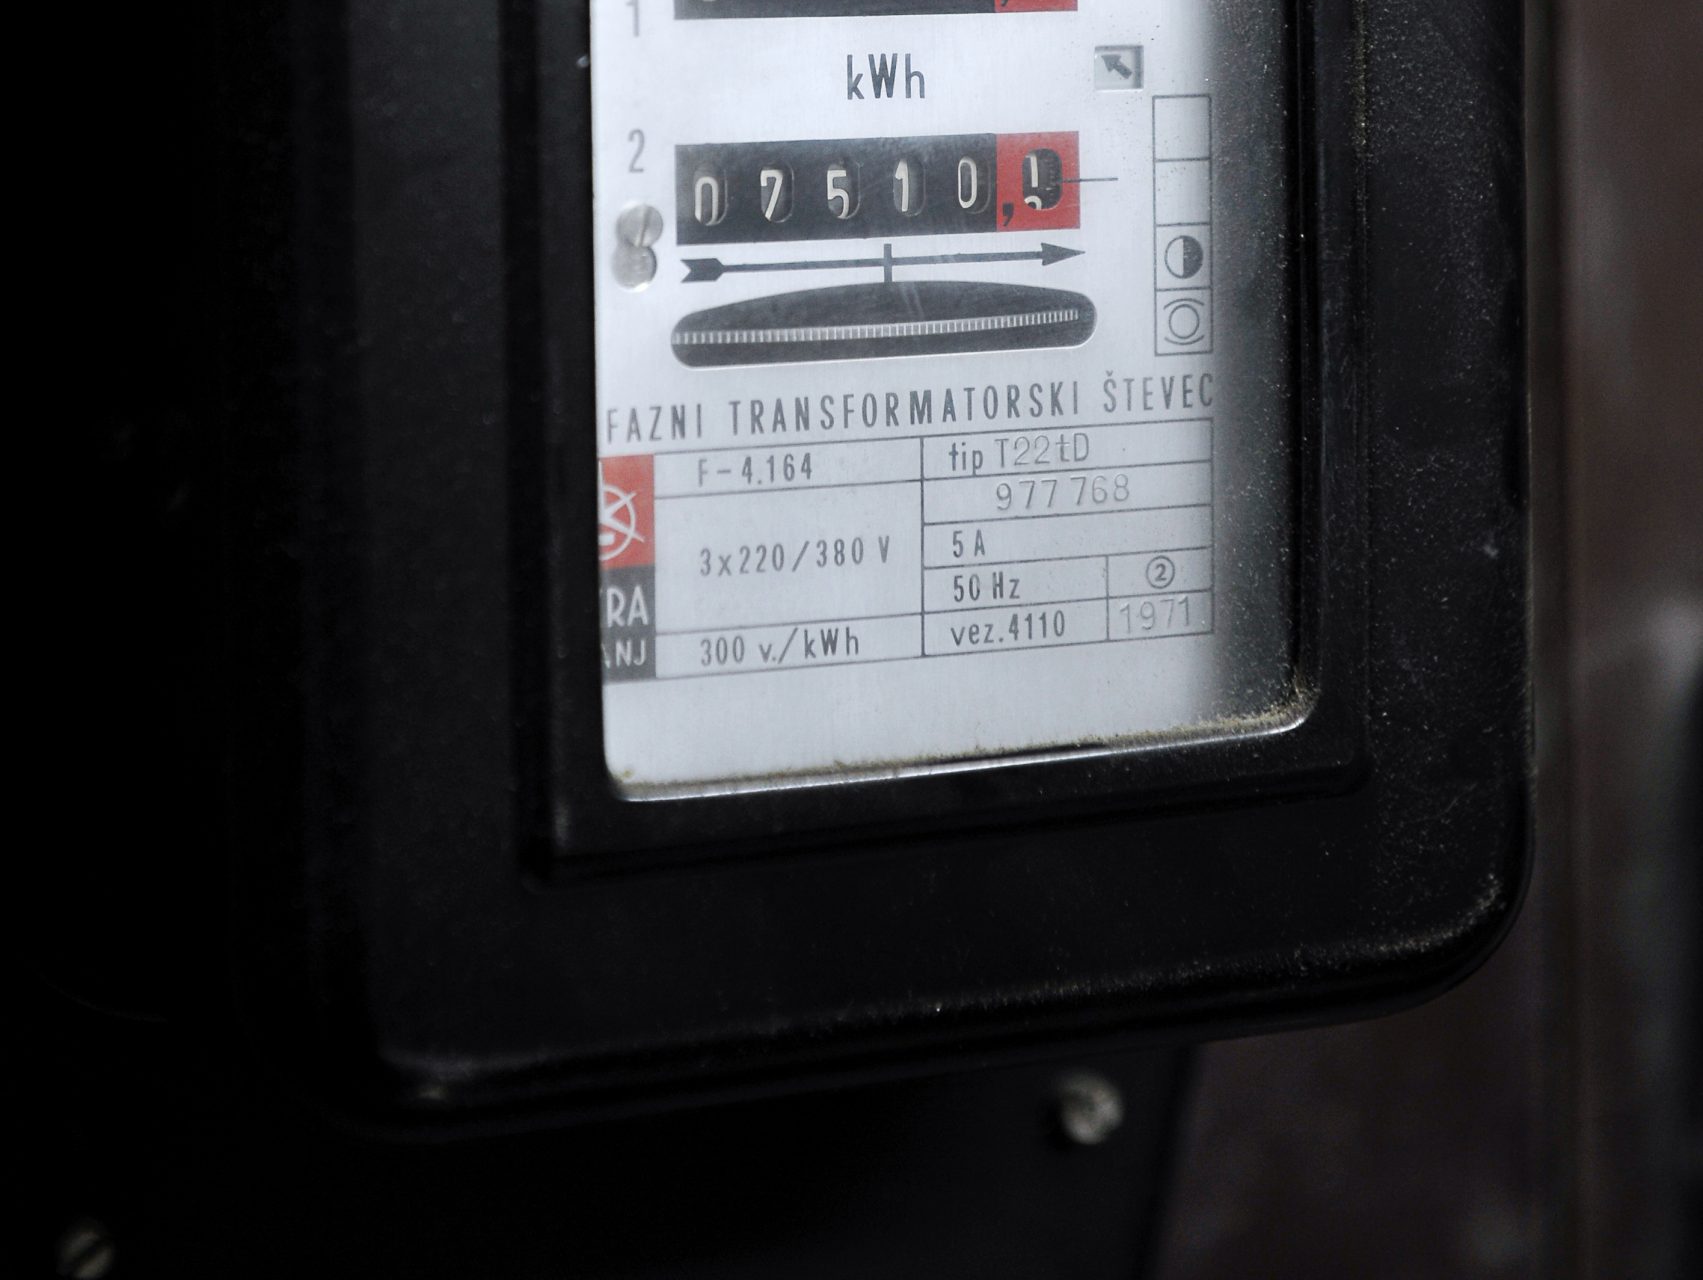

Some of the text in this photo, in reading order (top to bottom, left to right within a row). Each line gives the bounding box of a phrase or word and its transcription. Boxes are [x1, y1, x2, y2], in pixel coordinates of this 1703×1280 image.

[846, 53, 926, 101] kWh
[628, 128, 648, 174] 2
[606, 370, 1214, 445] FAZNI TRANSFORMATORSKI ŠTEVEC
[948, 441, 984, 477] tip
[700, 534, 891, 577] 3x220/380 V
[952, 528, 986, 559] 5 A
[601, 584, 649, 628] RA
[953, 570, 1020, 603] 50 Hz
[1119, 595, 1190, 635] 1971
[700, 635, 746, 667] 300
